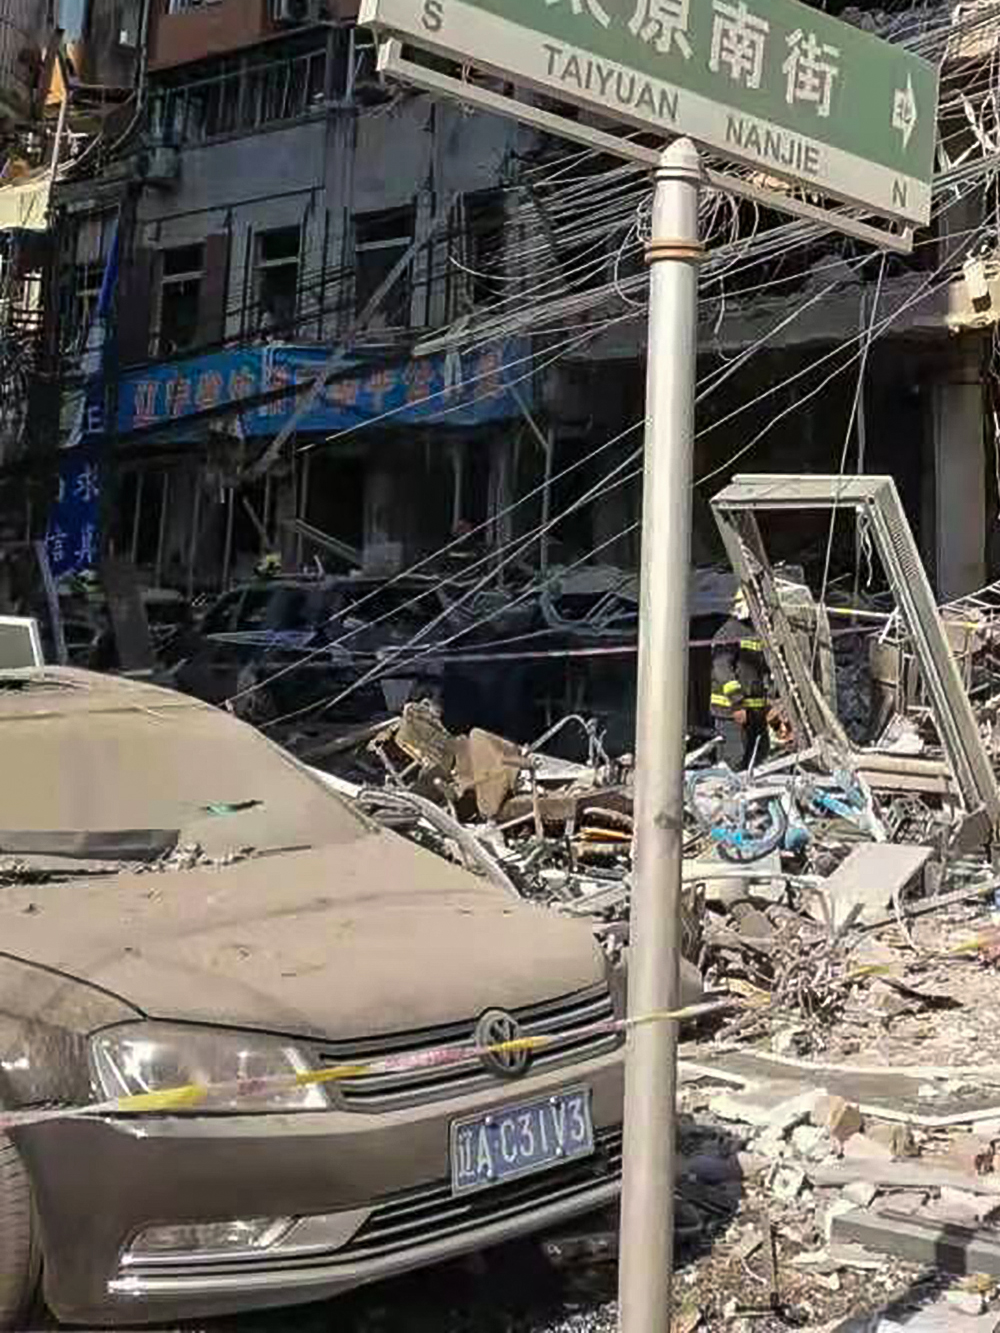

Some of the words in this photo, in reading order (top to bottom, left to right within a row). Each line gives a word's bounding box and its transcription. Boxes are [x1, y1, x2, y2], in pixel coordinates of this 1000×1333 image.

[542, 43, 679, 120] TAIYUAN
[725, 115, 821, 177] NANJIE
[891, 178, 908, 208] N
